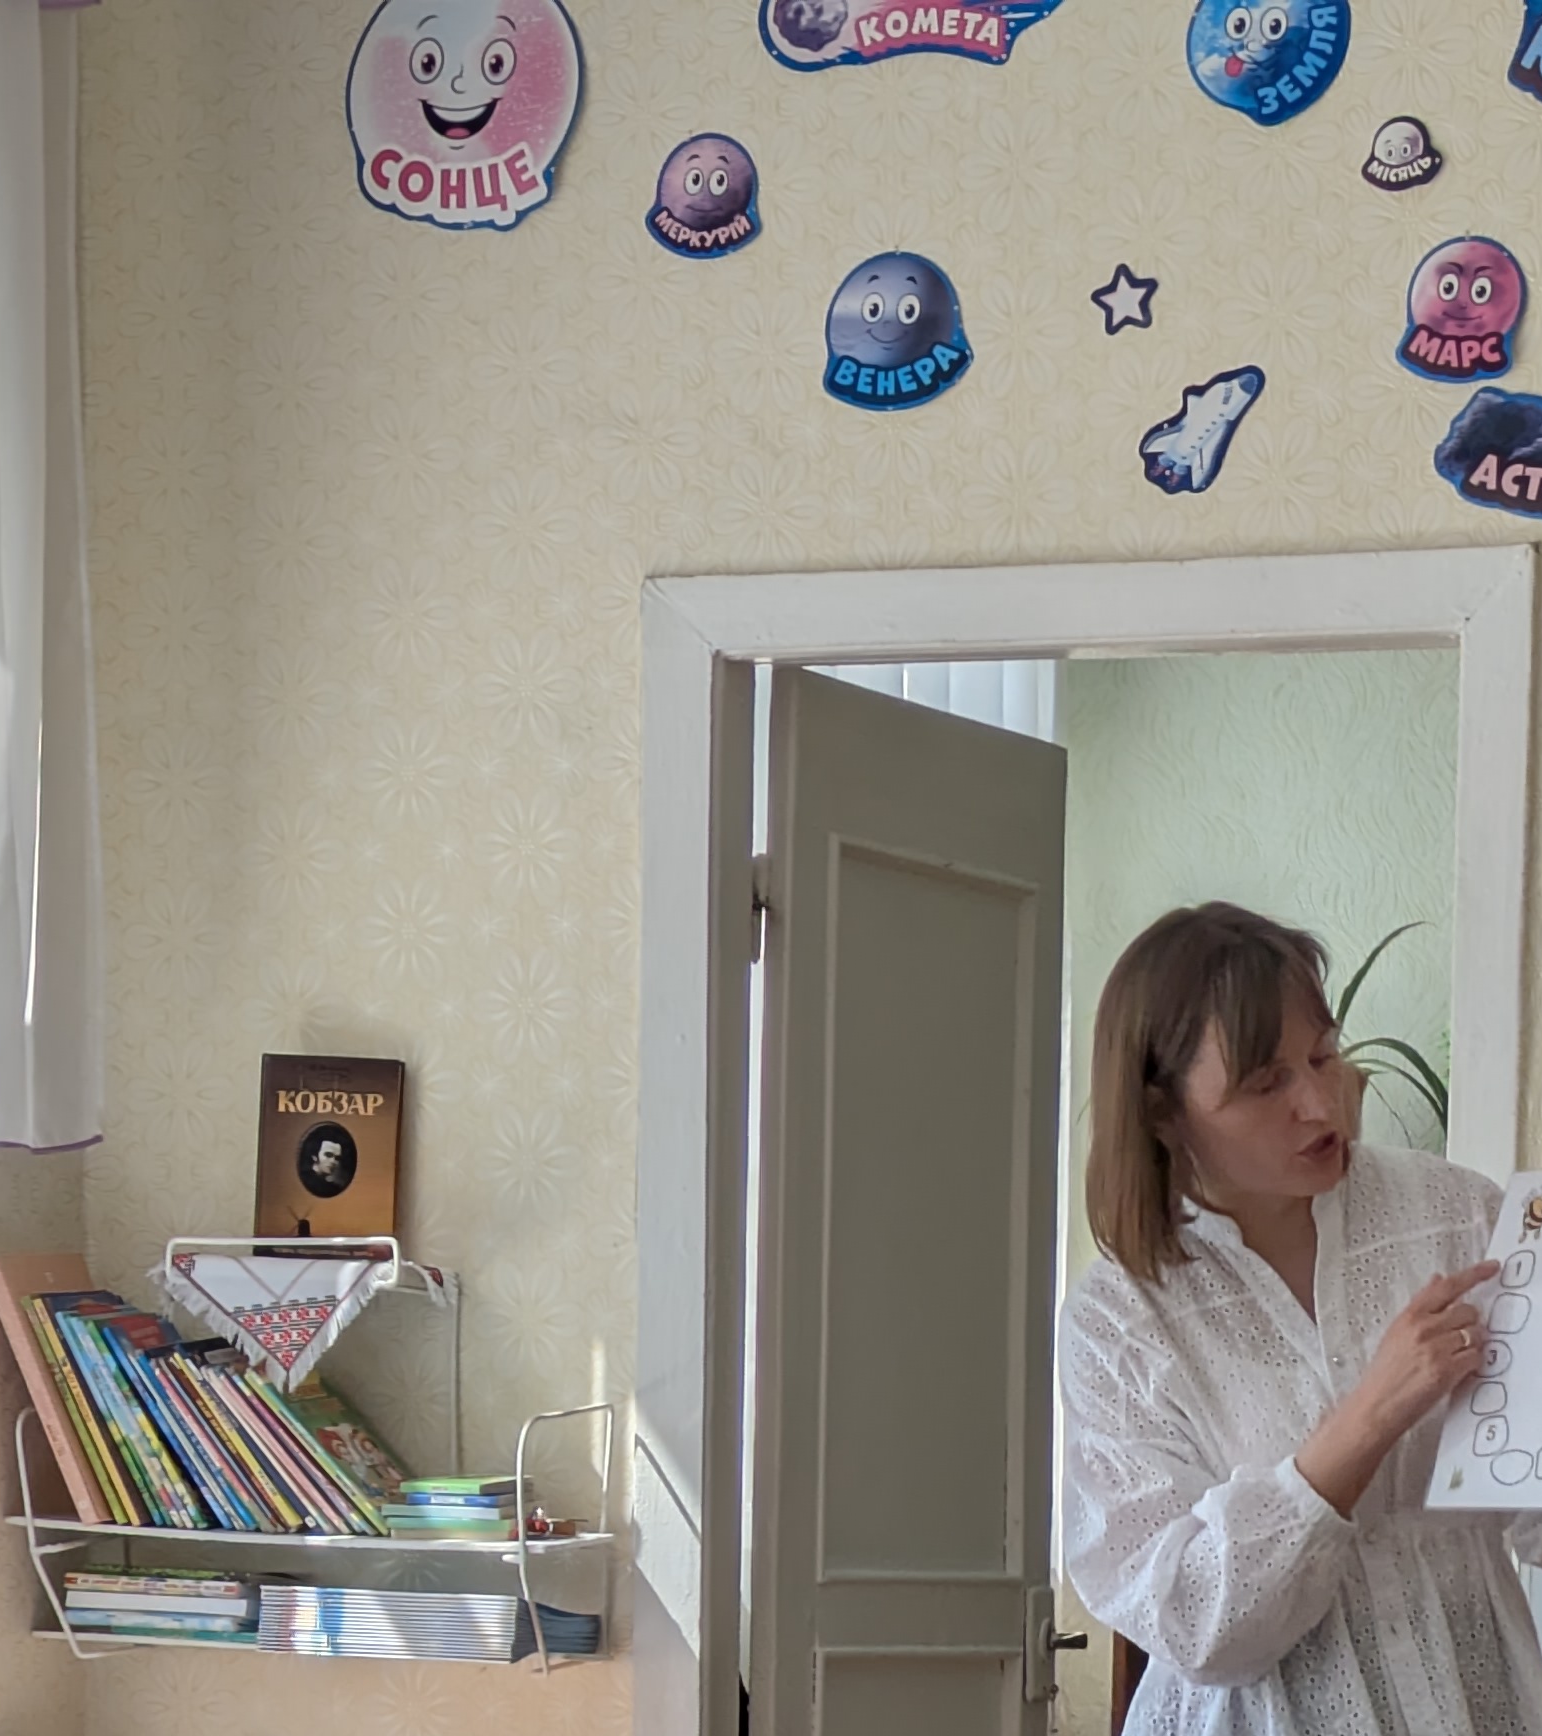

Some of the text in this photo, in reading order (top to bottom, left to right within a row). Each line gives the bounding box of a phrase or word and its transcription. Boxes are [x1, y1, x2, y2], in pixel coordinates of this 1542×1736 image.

[858, 5, 1001, 48] КОМЕТА
[1257, 0, 1340, 119] ЗЕМЛЯ
[368, 143, 543, 213] СОНЦЕ
[1366, 155, 1433, 183] МІСЯЦЬ
[652, 210, 753, 250] МЕРКУРІЙ
[1406, 328, 1502, 369] МАРС
[832, 342, 962, 397] ВЕНЕРА
[276, 1089, 385, 1116] КОБЗАР
[1515, 1261, 1523, 1276] 1
[1486, 1350, 1498, 1366] 3
[1485, 1425, 1496, 1441] 5
